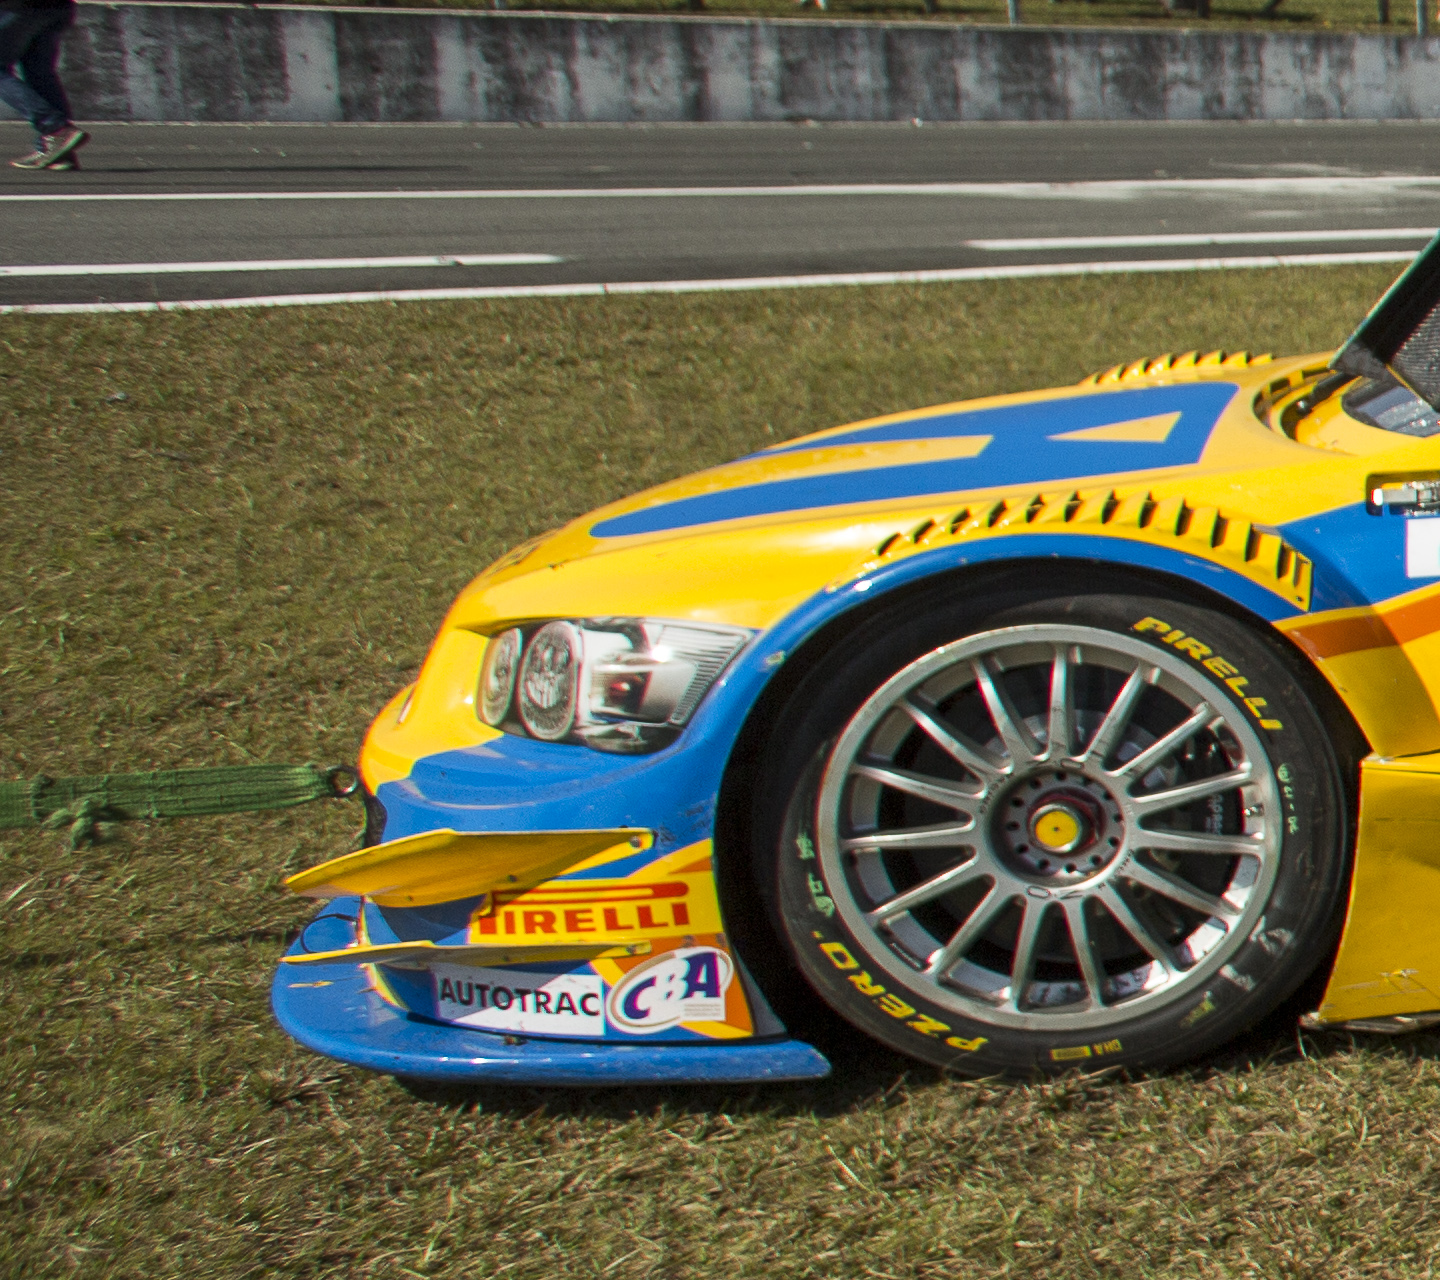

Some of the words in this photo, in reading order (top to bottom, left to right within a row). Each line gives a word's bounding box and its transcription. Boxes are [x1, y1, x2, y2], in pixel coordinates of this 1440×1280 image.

[1133, 616, 1283, 730] PIRELLI
[439, 977, 601, 1017] AUTOTRAC
[622, 951, 722, 1020] CBA
